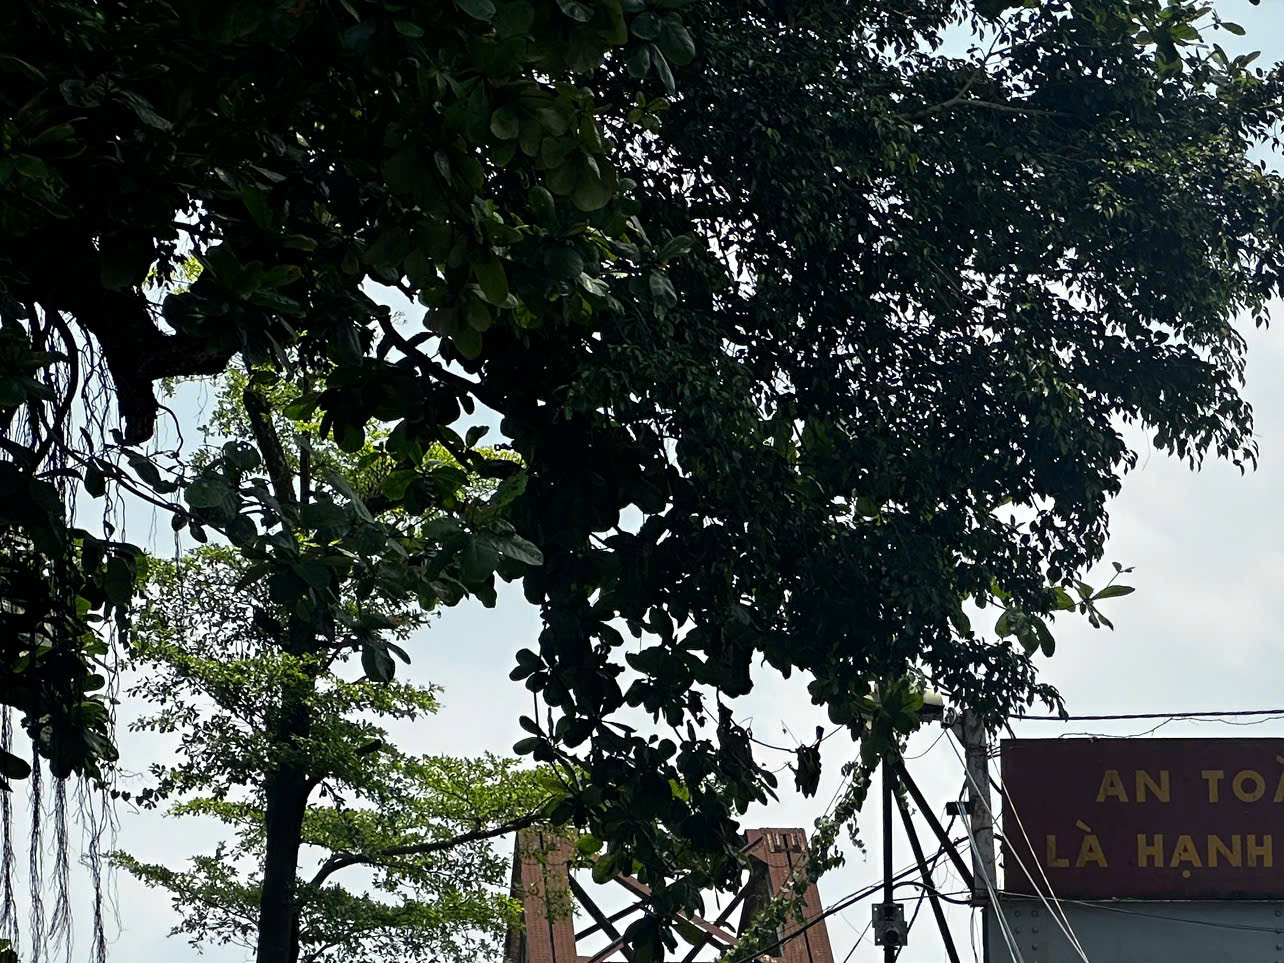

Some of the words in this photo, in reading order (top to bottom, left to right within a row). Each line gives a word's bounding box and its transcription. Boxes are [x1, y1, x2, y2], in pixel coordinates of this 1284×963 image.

[1095, 769, 1172, 803] AN
[1046, 818, 1109, 868] LÀ
[1136, 833, 1273, 878] HẠNH
